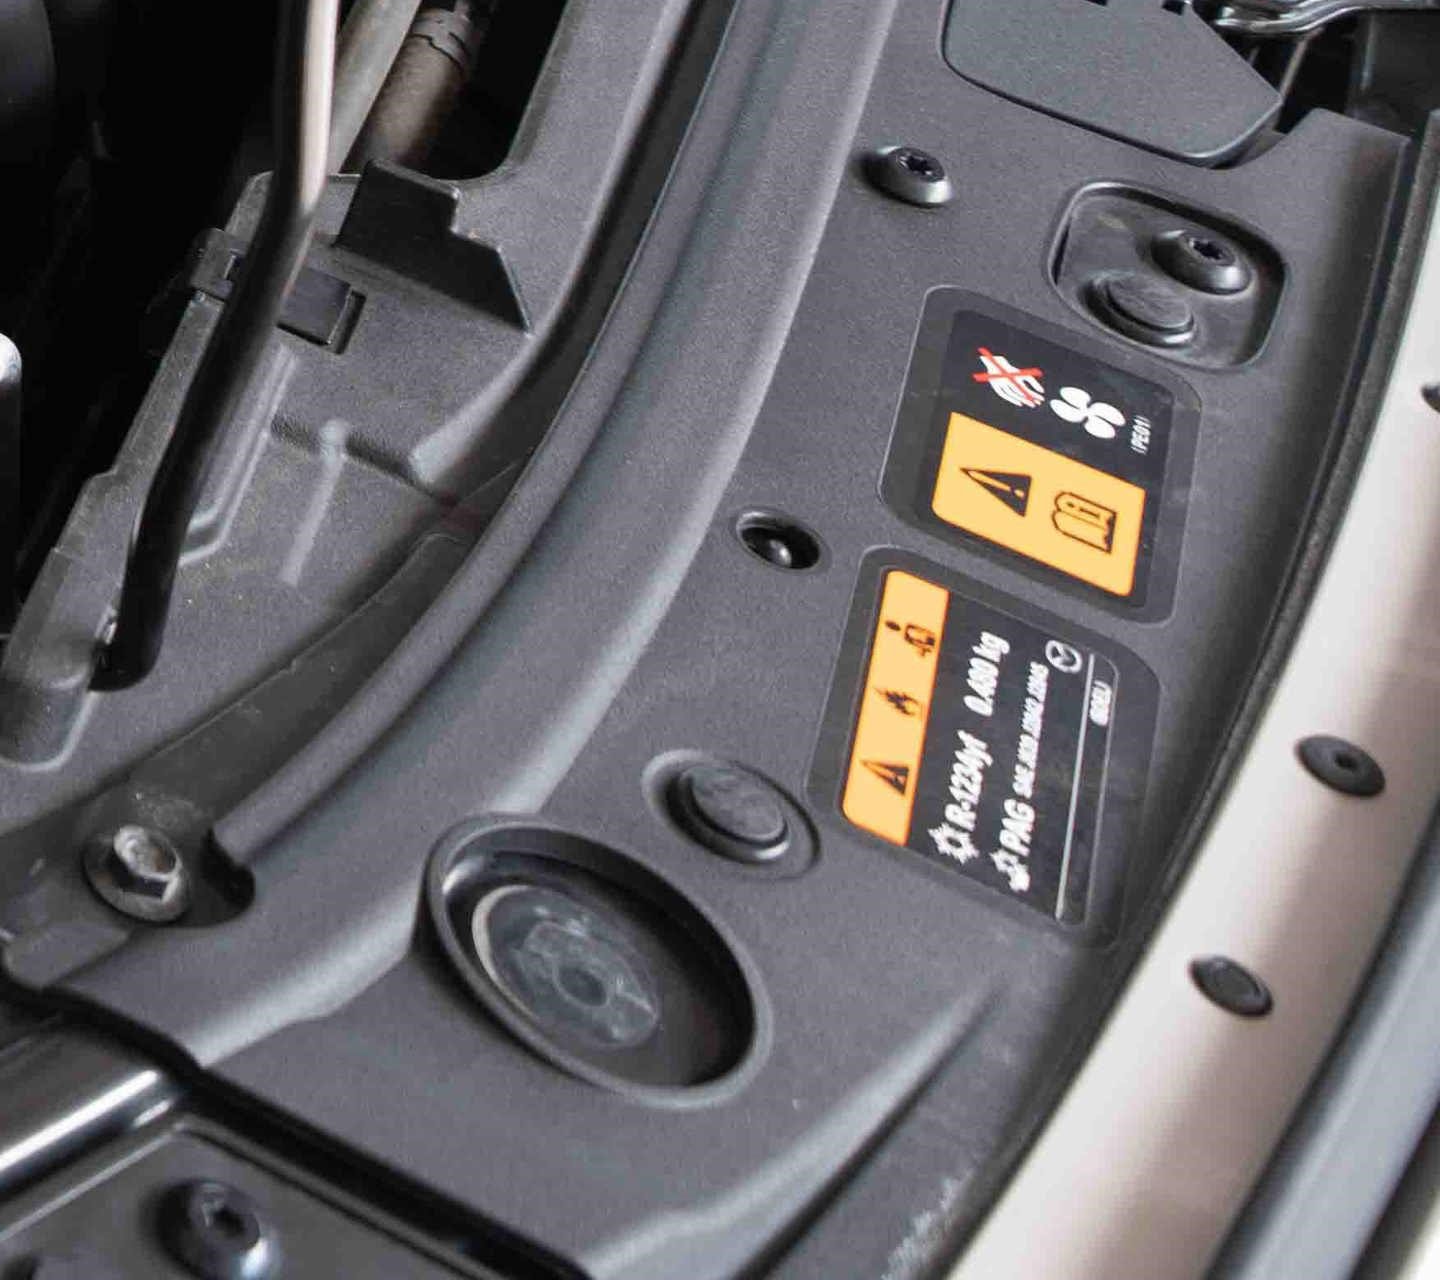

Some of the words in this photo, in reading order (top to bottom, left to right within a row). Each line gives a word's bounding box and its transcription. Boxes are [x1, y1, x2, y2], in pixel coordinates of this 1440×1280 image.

[944, 729, 994, 833] R-1234yf
[971, 631, 1011, 662] kg
[998, 798, 1035, 857] PAG
